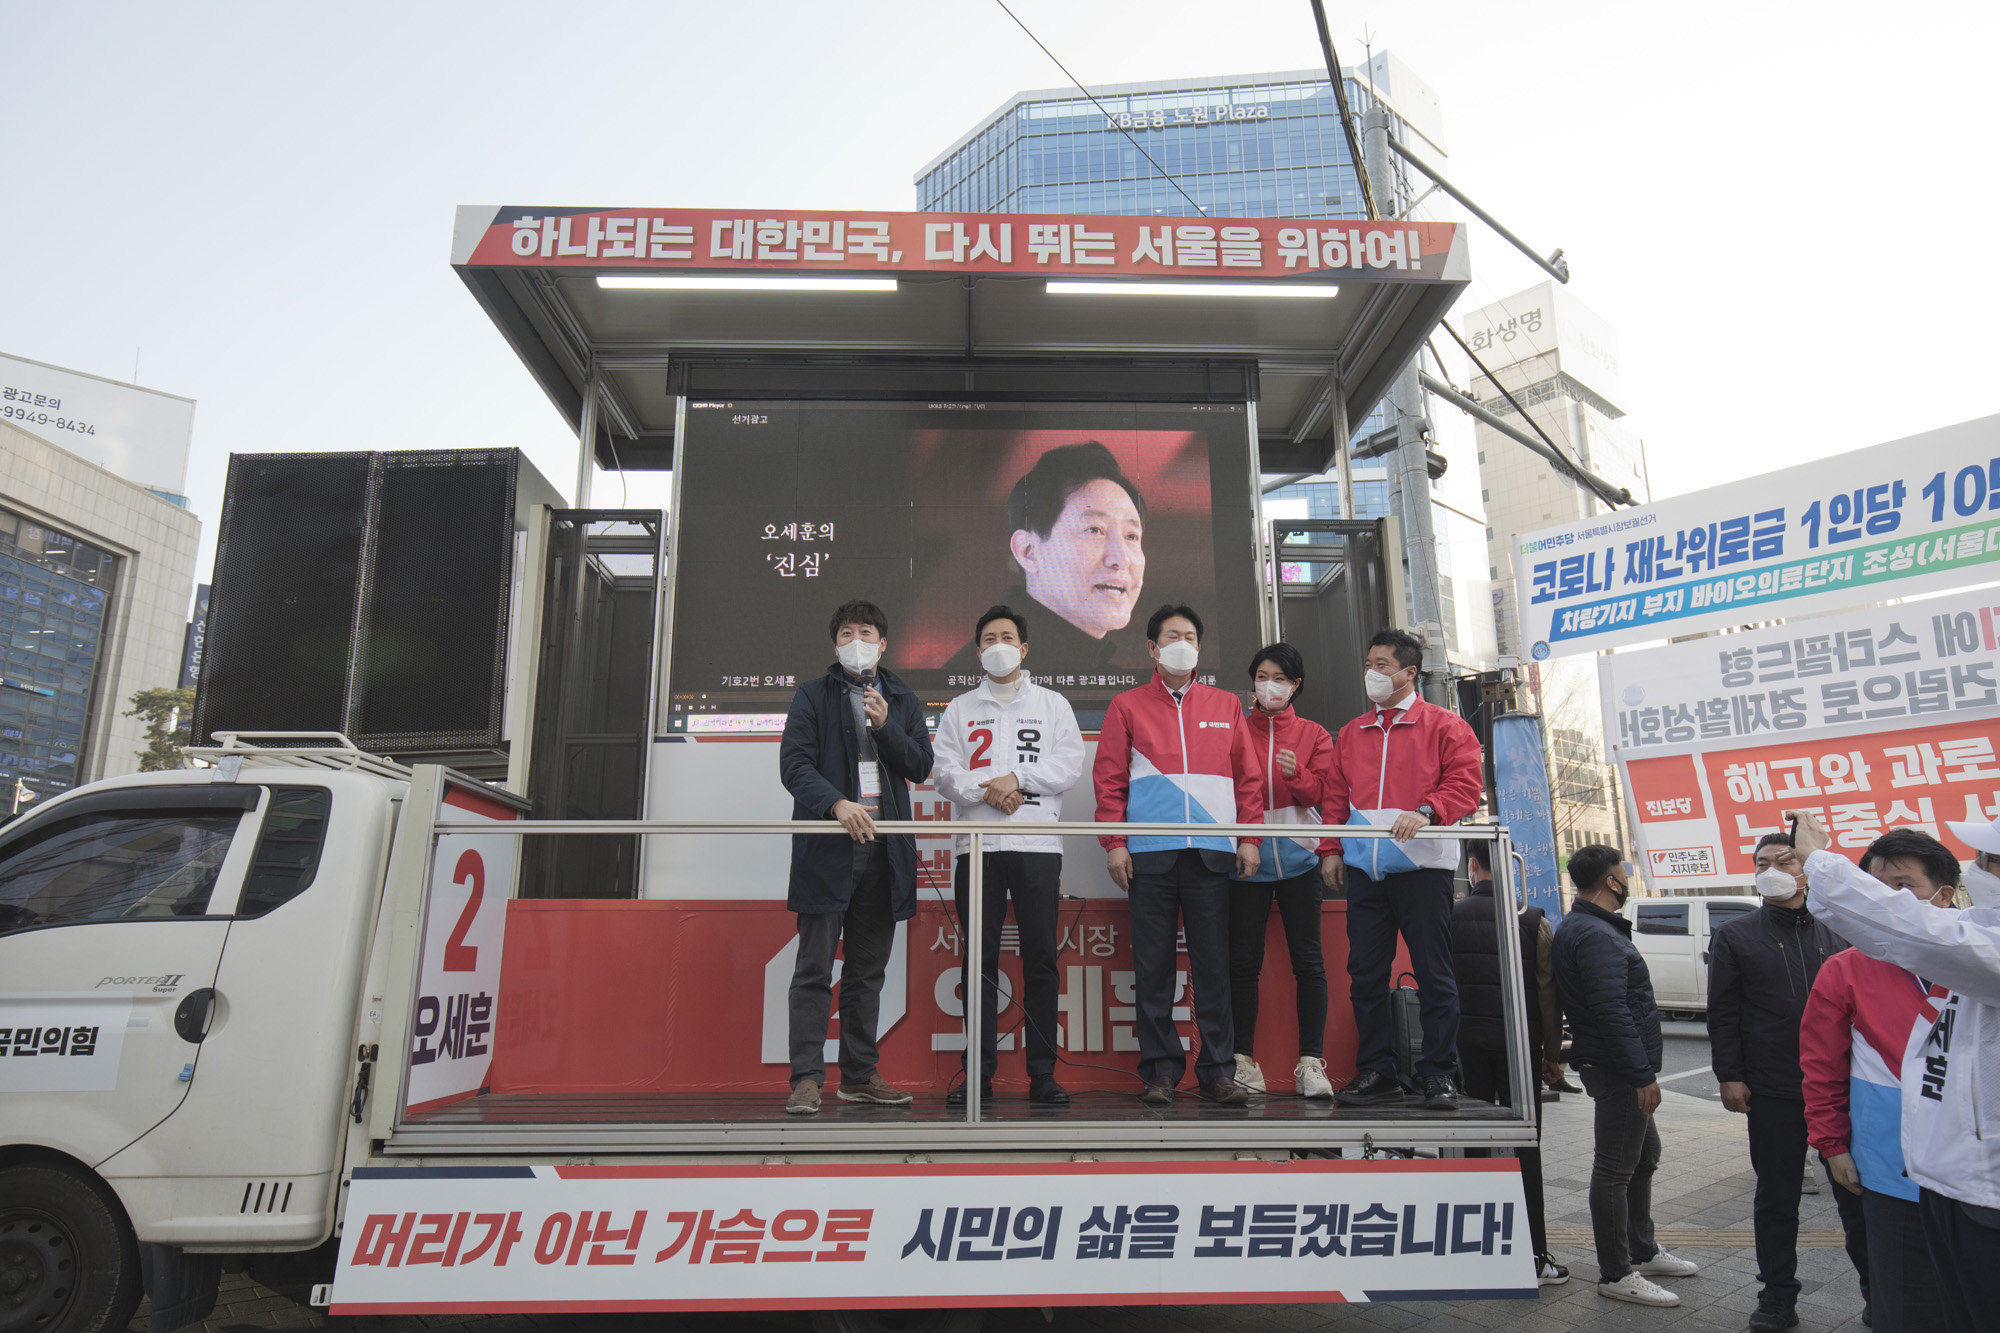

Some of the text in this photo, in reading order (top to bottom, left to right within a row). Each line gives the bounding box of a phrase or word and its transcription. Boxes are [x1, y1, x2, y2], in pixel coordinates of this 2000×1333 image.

[1107, 104, 1268, 129] KB금융 노원 Plaza
[511, 215, 1421, 270] 하나되는 대한민국, 다시 뛰는 서울을 위하여!
[1466, 307, 1542, 353] 화생명
[2, 386, 61, 410] 광고문의
[760, 522, 834, 541] 오세훈의
[1520, 532, 1575, 555] 더불어민주당
[1531, 546, 1615, 604] 코로나
[1623, 507, 1786, 586] 재난위로금
[1800, 479, 1906, 550] 1인당
[1560, 599, 1637, 633] 차량기지
[1642, 588, 1684, 617] 부지
[1691, 554, 1854, 608] 바이오의료단지
[721, 675, 796, 687] 기호2번 오세훈
[1056, 675, 1075, 686] 따른
[1079, 675, 1139, 686] 광고물입니다.
[1198, 675, 1217, 686] 세훈
[967, 728, 993, 771] 2
[1724, 750, 1871, 802] 해고와
[1645, 797, 1692, 817] 진보당
[1668, 850, 1708, 863] 민주노총
[1670, 862, 1711, 874] 지지후보
[442, 848, 485, 972] 2
[95, 976, 167, 988] PORTER
[411, 992, 493, 1066] 오세훈
[350, 1202, 1515, 1268] 머리가 아닌 가슴으로 시민의 삶을 보듬겠습니다!
